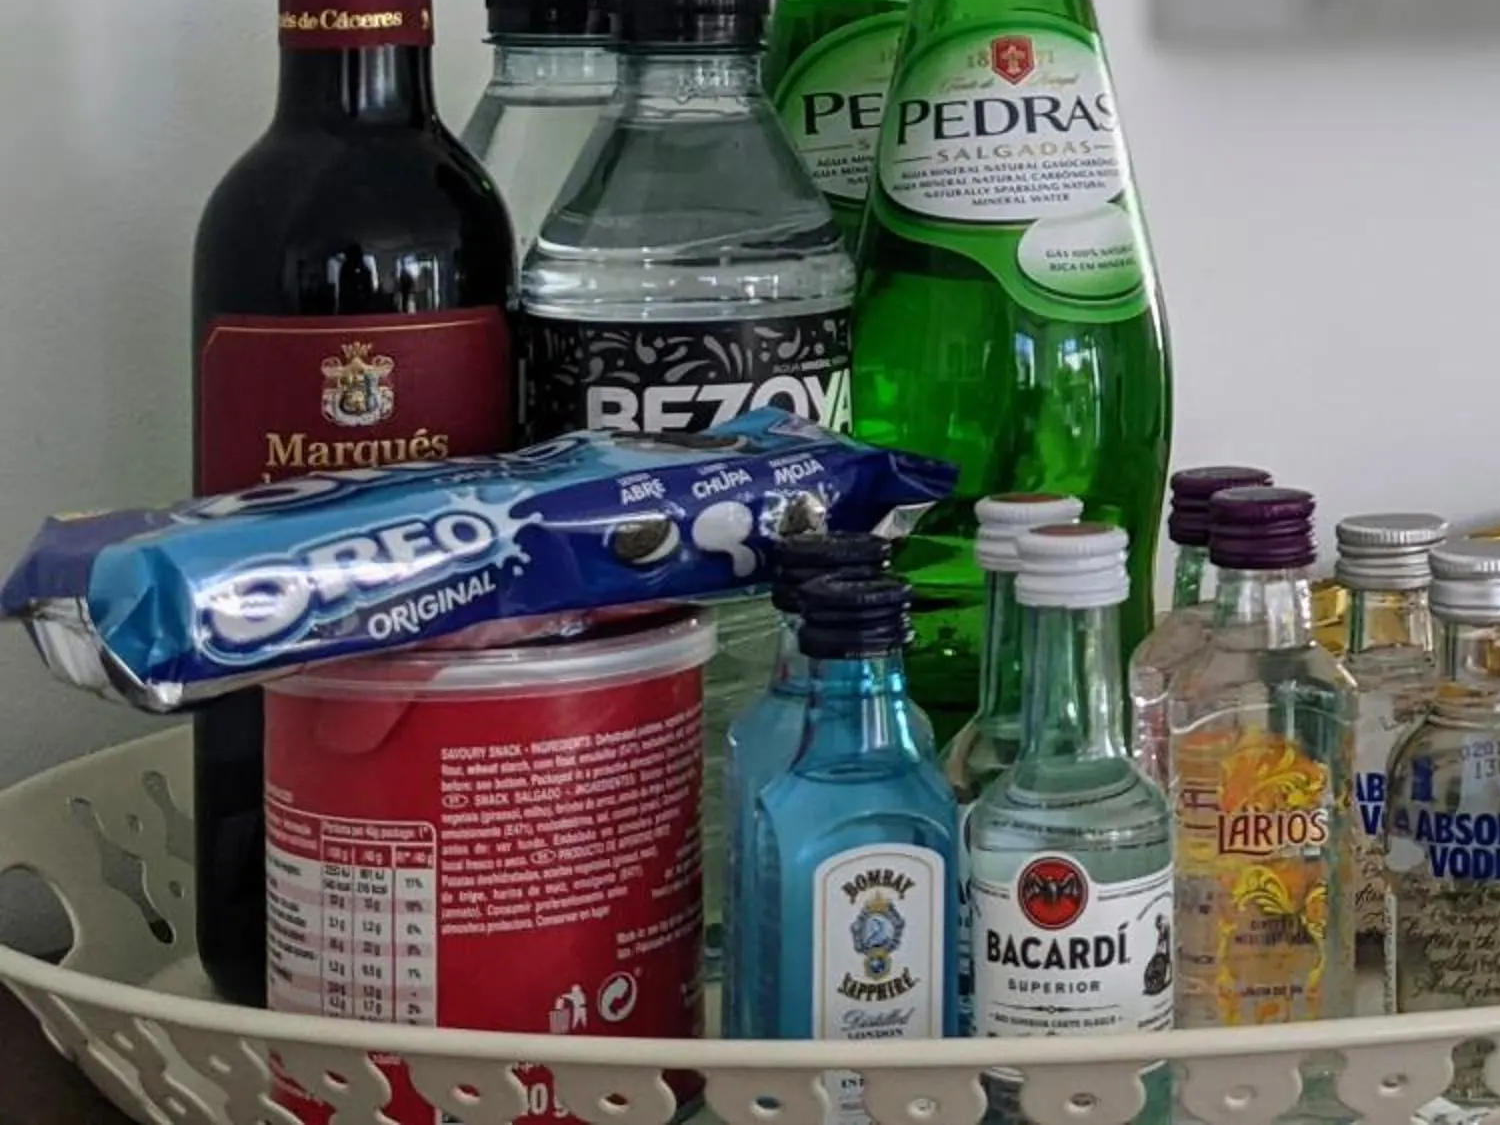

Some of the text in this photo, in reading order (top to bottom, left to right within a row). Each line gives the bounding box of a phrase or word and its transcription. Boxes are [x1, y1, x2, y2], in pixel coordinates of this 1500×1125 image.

[897, 93, 1115, 145] PEDRAS
[936, 140, 1092, 163] SALGADAS
[1031, 194, 1070, 204] WATER
[587, 368, 852, 433] BEZOYA
[266, 428, 449, 468] Marqués
[692, 468, 752, 500] CHUPA
[774, 458, 824, 486] MOJA
[620, 477, 666, 506] ABRE
[205, 508, 496, 646] OREO
[367, 574, 496, 641] ORIGINAL
[474, 793, 509, 806] SNACK
[514, 786, 561, 804] SALGADO
[1218, 808, 1329, 856] LARIOS
[841, 868, 916, 904] BOMBAY
[986, 922, 1129, 970] BACARDÍ
[837, 967, 918, 1002] SAPPHIRE
[1008, 978, 1102, 994] SUPERIOR
